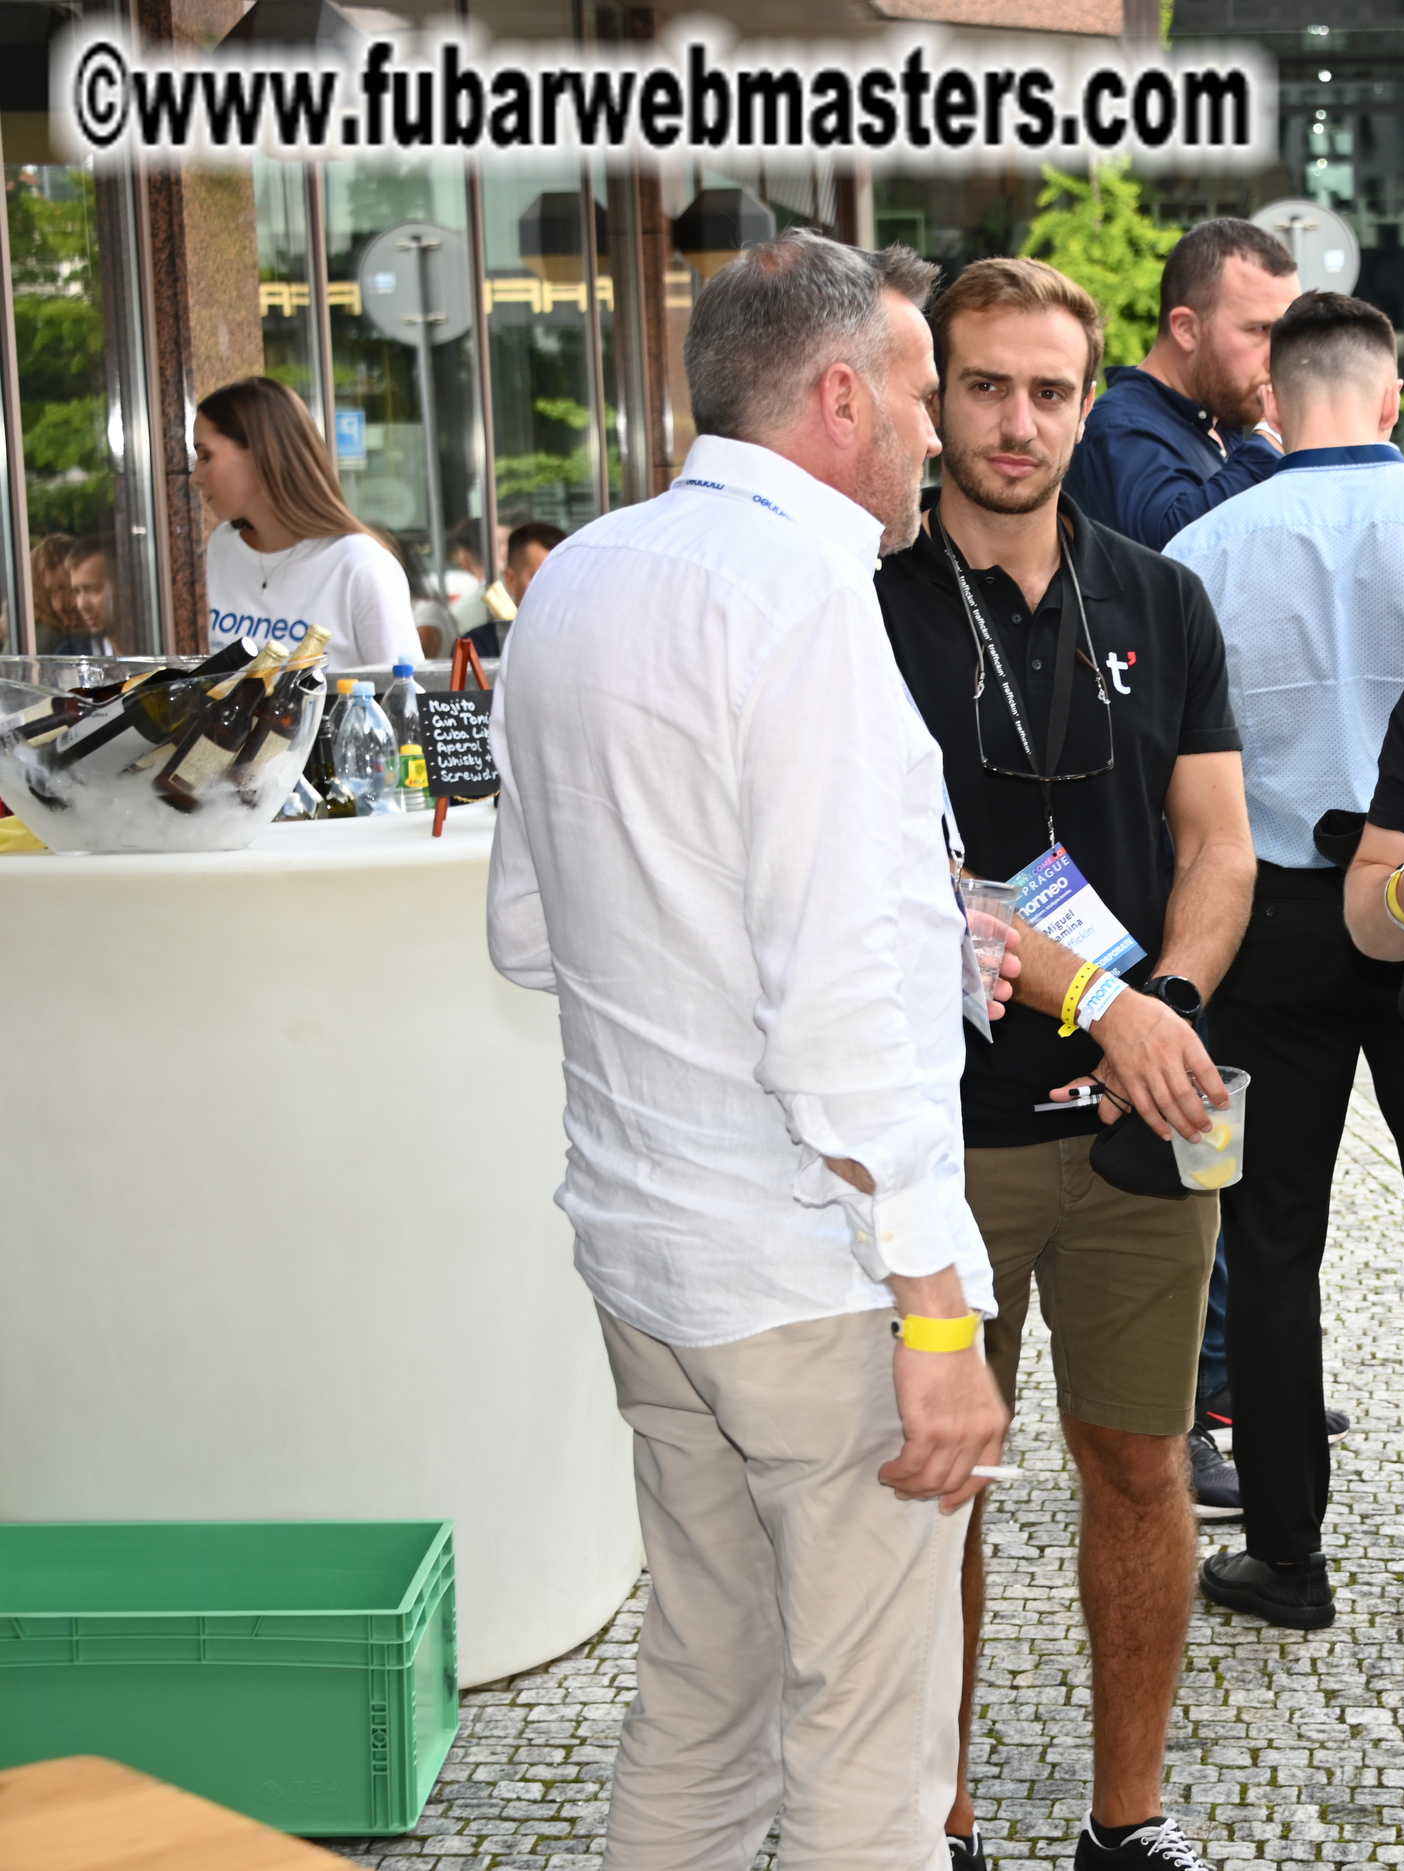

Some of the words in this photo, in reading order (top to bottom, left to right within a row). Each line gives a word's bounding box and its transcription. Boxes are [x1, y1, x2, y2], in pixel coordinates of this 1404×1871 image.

[428, 699, 475, 716] Mojito
[988, 644, 1006, 678] traffickin'
[1002, 682, 1019, 717] traffickin'
[1015, 720, 1032, 755] traffickin'
[432, 715, 457, 728] Gin
[459, 712, 490, 726] Toni
[433, 728, 470, 740] Cuba
[437, 740, 482, 755] Aperol
[438, 754, 482, 770] Whisky
[440, 767, 499, 782] Screwdr
[1022, 855, 1070, 896] PRAGUE
